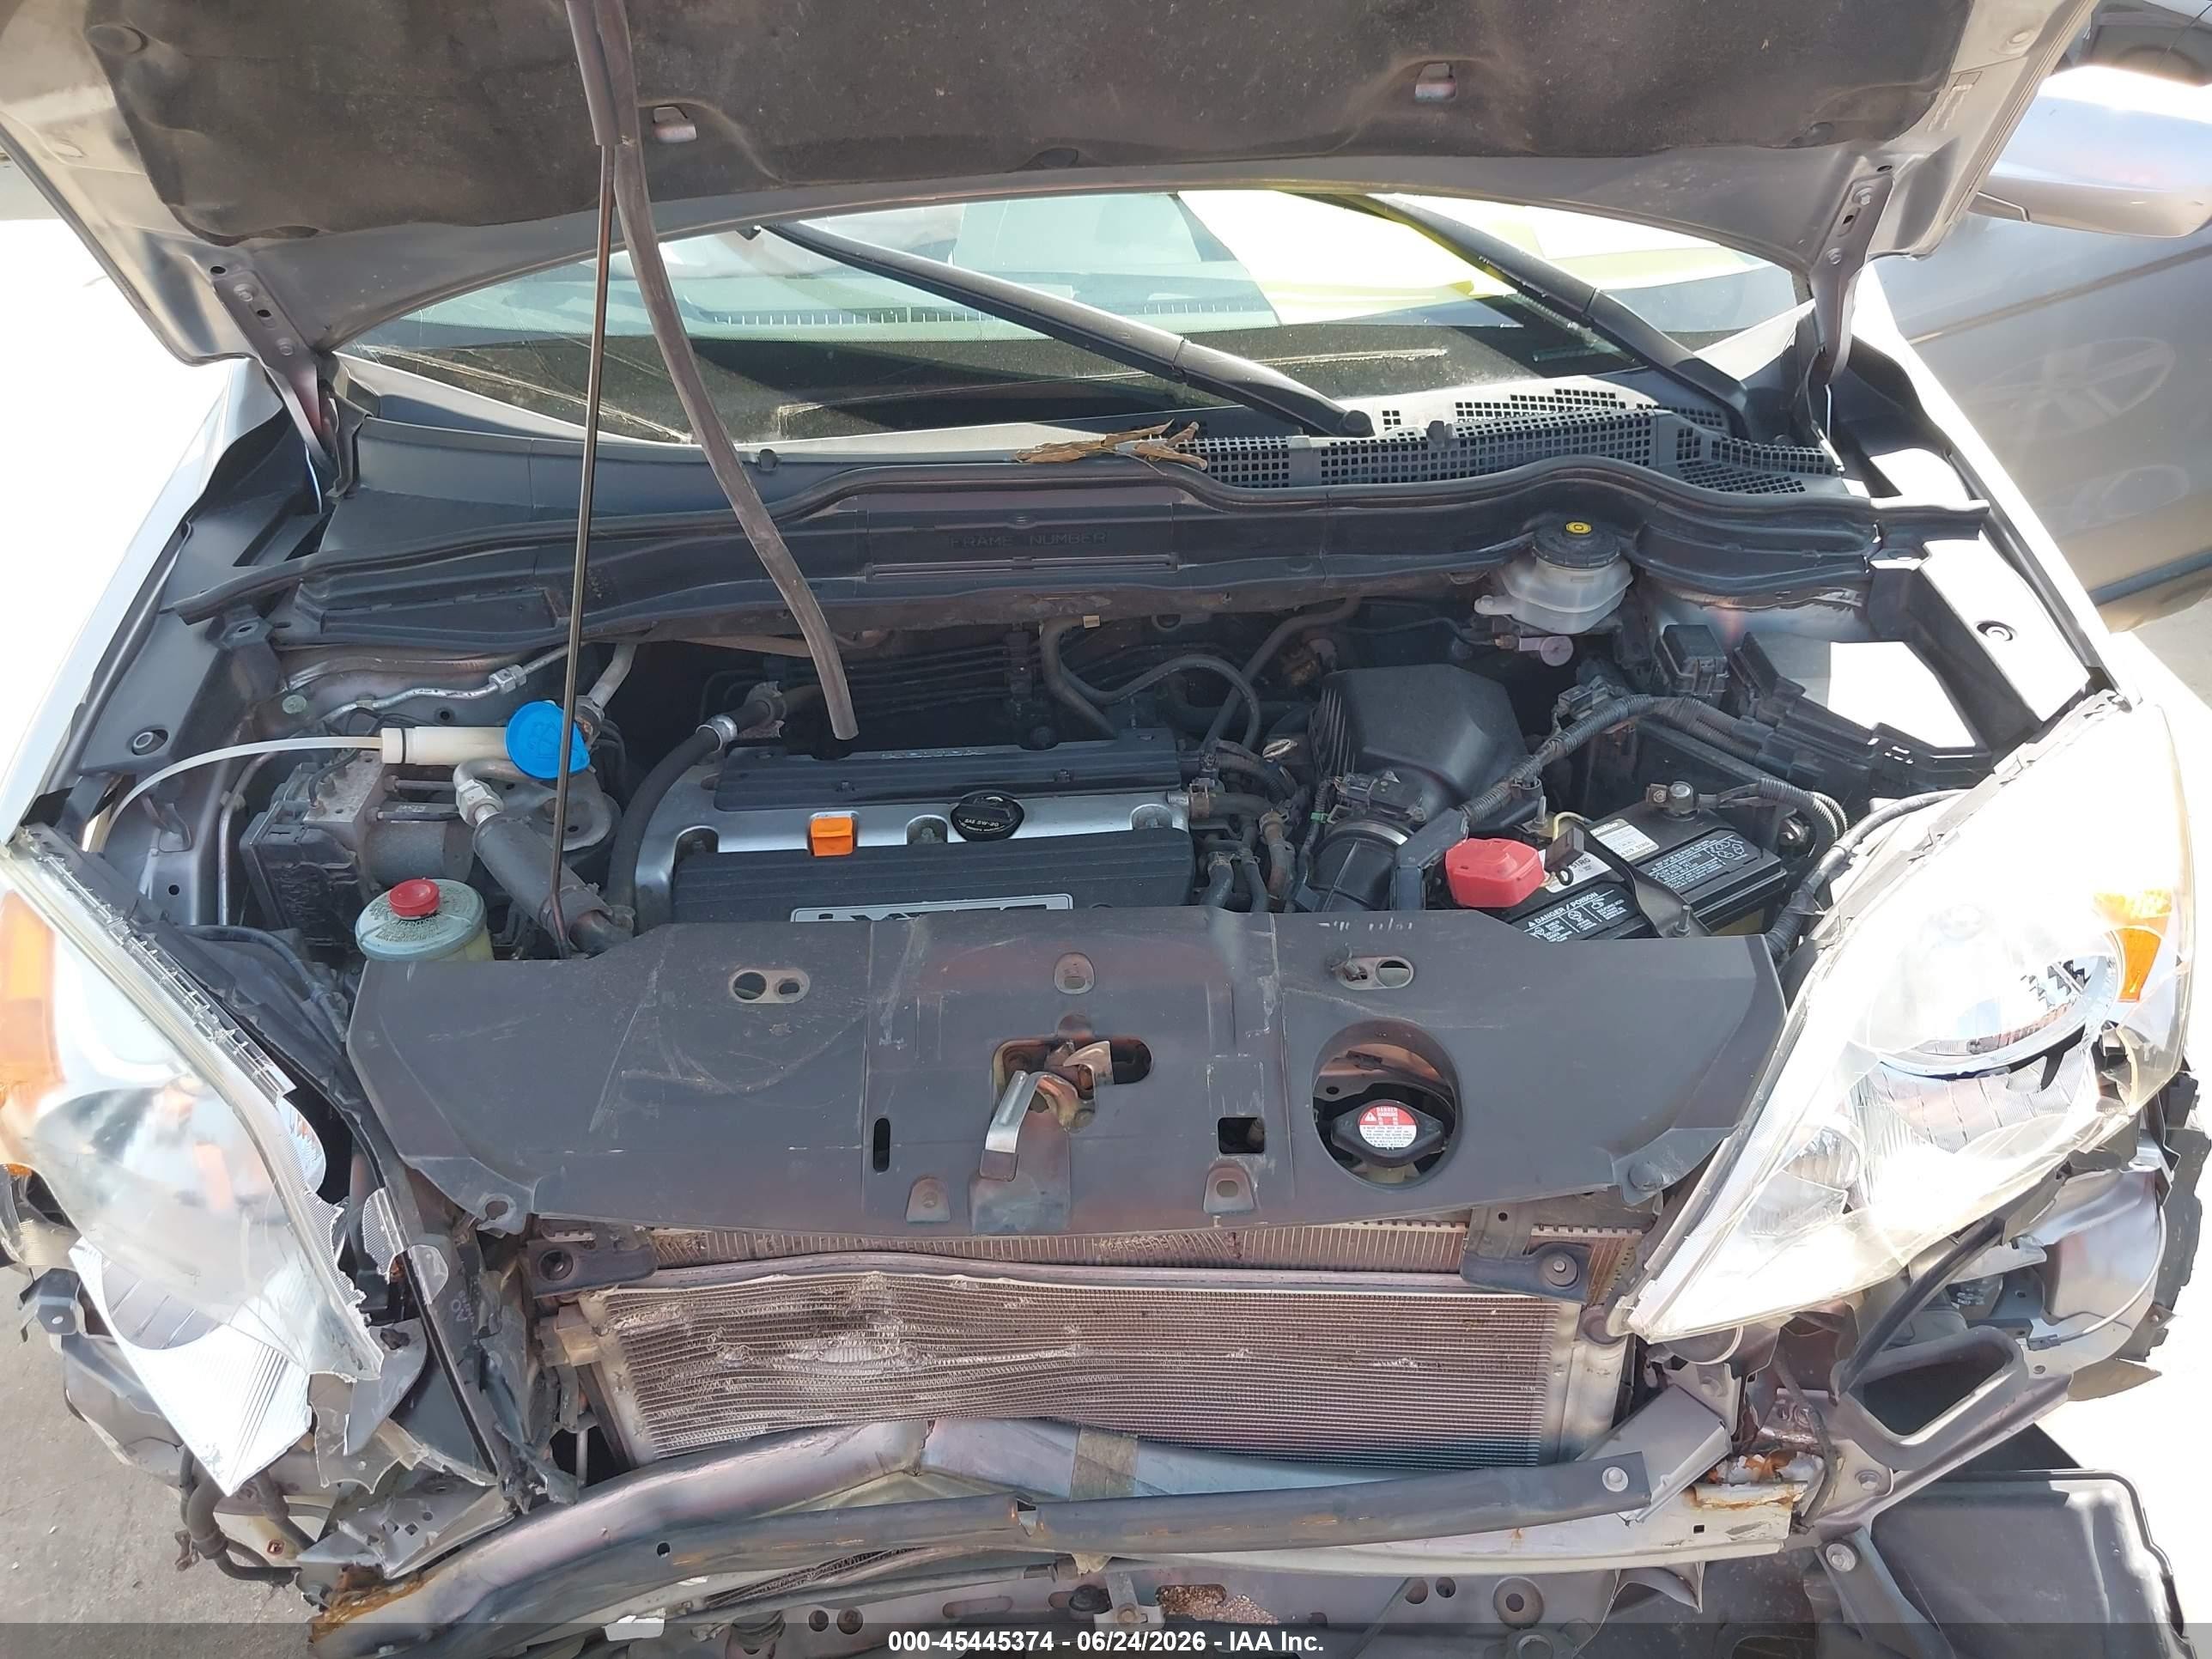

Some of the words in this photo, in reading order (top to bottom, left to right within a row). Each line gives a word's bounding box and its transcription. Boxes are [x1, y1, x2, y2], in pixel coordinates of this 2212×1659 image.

[950, 535, 1014, 549] FRAME
[1030, 531, 1107, 545] NUMBER
[1534, 907, 1566, 925] DANGER
[1570, 891, 1598, 907] POISON
